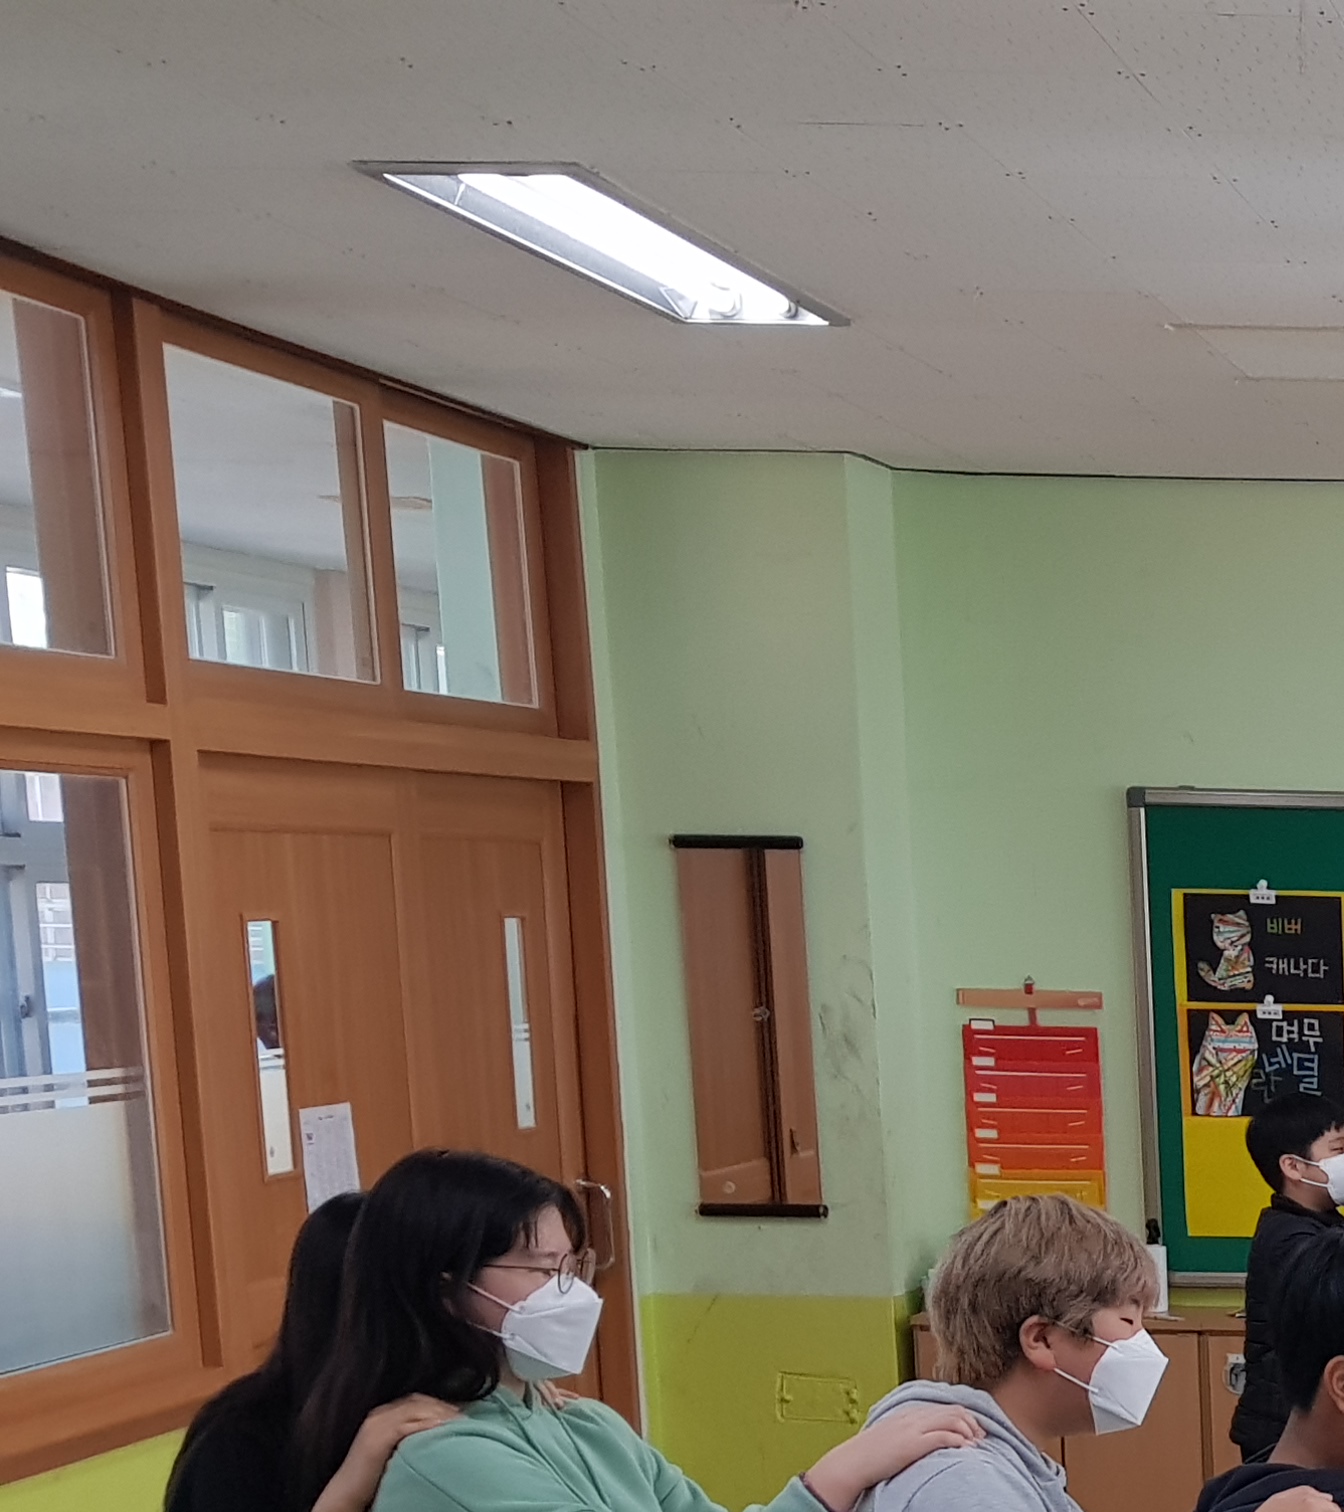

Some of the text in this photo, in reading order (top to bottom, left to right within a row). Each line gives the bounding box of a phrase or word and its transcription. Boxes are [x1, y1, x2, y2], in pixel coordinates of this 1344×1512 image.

[827, 870, 894, 907] MARVEL
[1267, 918, 1302, 934] 비버
[1265, 957, 1329, 979] 캐나다
